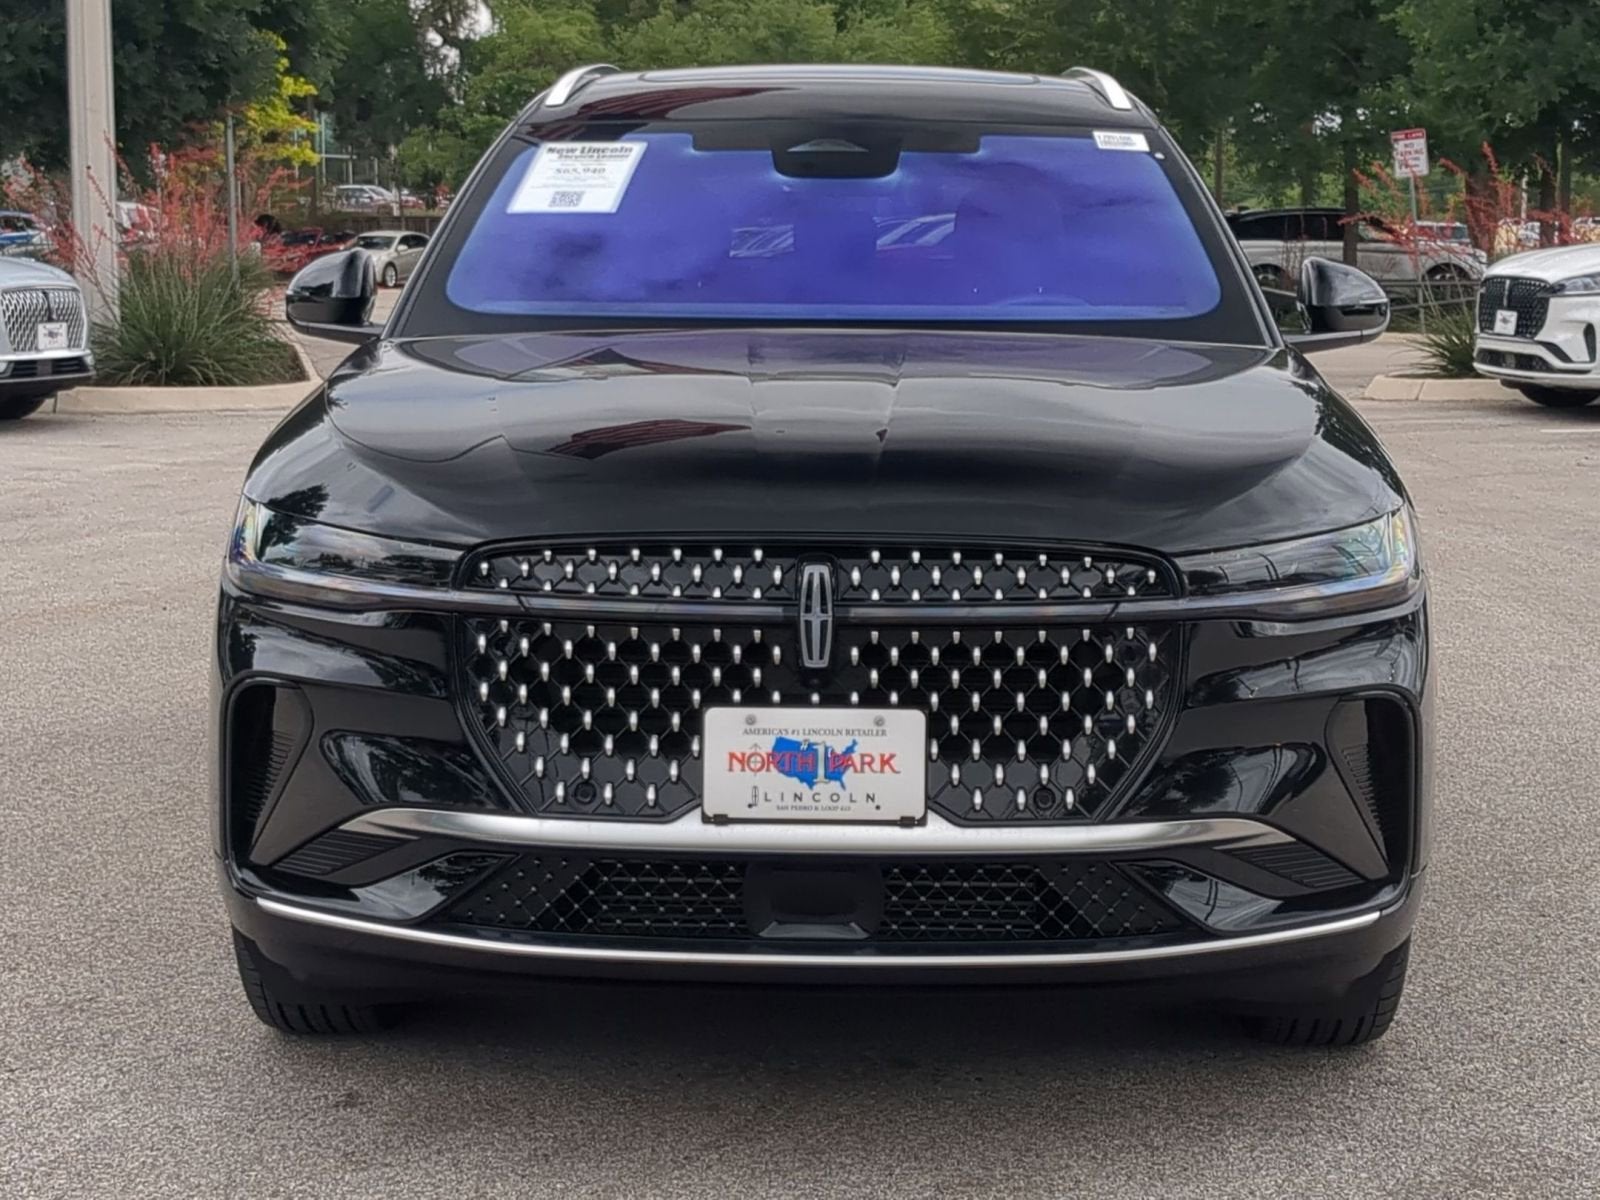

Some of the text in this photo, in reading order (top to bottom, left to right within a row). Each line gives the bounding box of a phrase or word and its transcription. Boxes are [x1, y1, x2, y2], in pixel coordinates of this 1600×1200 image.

[580, 146, 633, 154] Lincoln
[742, 728, 887, 737] AMERICA'S #1 LINCOLN RETAILER
[728, 752, 900, 774] NORTH PARK
[764, 792, 876, 803] LINCOLN
